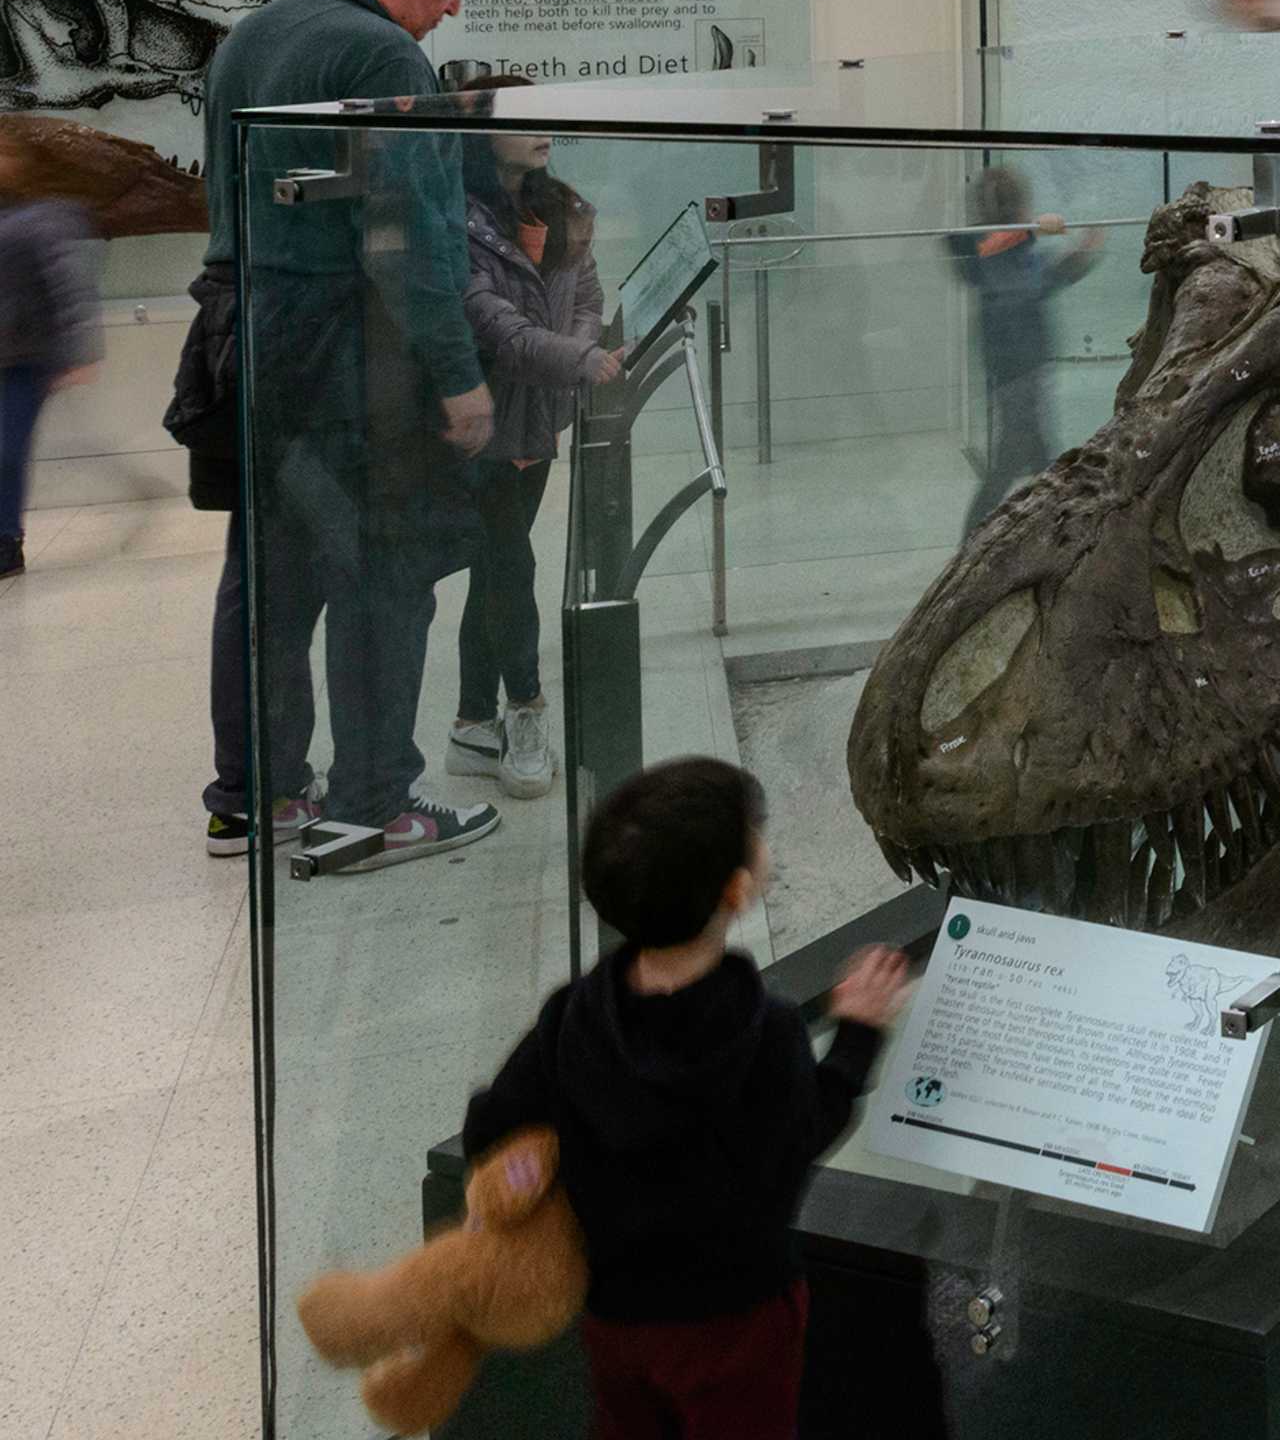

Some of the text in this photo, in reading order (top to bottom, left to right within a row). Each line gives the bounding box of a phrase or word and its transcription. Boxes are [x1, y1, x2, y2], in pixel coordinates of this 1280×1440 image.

[465, 3, 715, 19] teeth help both to kill the prey and to
[465, 21, 494, 33] slice
[499, 21, 519, 32] the
[524, 20, 557, 31] meat
[562, 19, 605, 30] before
[497, 55, 689, 77] Teeth and Diet
[975, 925, 997, 936] skull
[997, 931, 1015, 940] and
[1014, 932, 1036, 944] jaws
[952, 944, 1042, 972] Tyrannosaurus
[1043, 964, 1065, 977] rex
[939, 983, 957, 995] This
[988, 994, 1004, 1005] the
[1004, 997, 1024, 1009] first
[1023, 1003, 1064, 1018] complete
[936, 1020, 953, 1029] one
[953, 1023, 965, 1032] of
[964, 1024, 980, 1035] the
[980, 1029, 1003, 1040] most
[1131, 1063, 1146, 1072] are
[1195, 1075, 1223, 1090] Fewer
[963, 1014, 981, 1024] one
[981, 1017, 993, 1026] of
[991, 1018, 1007, 1029] the
[1006, 1021, 1026, 1034] best
[1025, 1025, 1065, 1042] theropod
[1124, 1047, 1166, 1065] Although
[1006, 1009, 1037, 1024] hunter
[1075, 1024, 1105, 1039] Brown
[1106, 1033, 1149, 1048] collected
[1201, 1053, 1221, 1064] and
[919, 1038, 950, 1053] largest
[949, 1047, 968, 1057] and
[968, 1051, 991, 1062] most
[991, 1054, 1032, 1071] fearsome
[1074, 1074, 1086, 1084] of
[1128, 1085, 1152, 1099] Note
[1153, 1091, 1170, 1103] the
[1170, 1096, 1217, 1114] enormous
[985, 1043, 1029, 1059] specimens
[1029, 1050, 1051, 1063] have
[1051, 1055, 1074, 1069] been
[1184, 1087, 1202, 1098] was
[1203, 1089, 1220, 1101] the
[980, 1064, 997, 1075] The
[1078, 1087, 1105, 1102] along
[1106, 1092, 1128, 1106] their
[1128, 1098, 1155, 1112] edges
[1156, 1106, 1172, 1116] are
[1197, 1113, 1213, 1125] for
